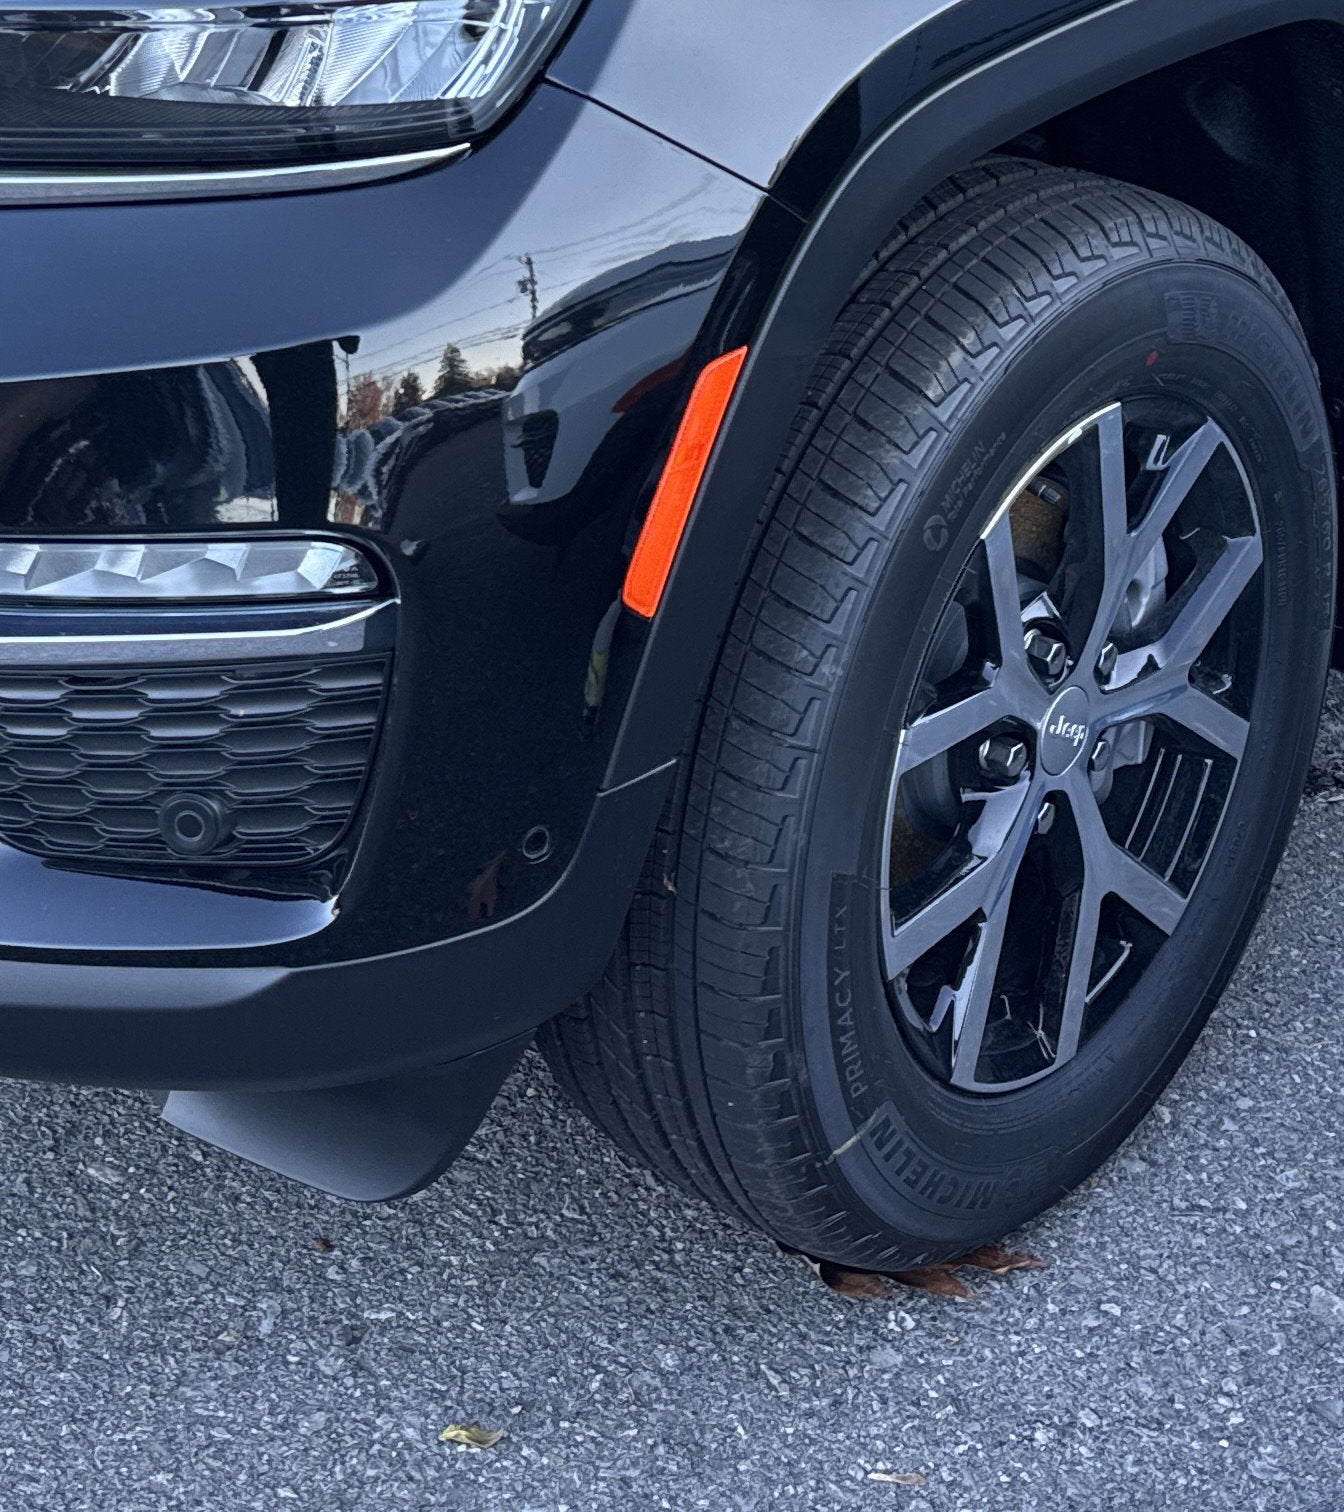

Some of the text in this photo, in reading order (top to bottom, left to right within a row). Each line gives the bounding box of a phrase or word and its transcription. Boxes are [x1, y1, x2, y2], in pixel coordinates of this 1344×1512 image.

[940, 440, 986, 513] MICHELIN
[1049, 714, 1086, 747] Jeep
[834, 905, 869, 1099] PRIMACY LTX
[869, 1114, 998, 1210] MICHELIN
